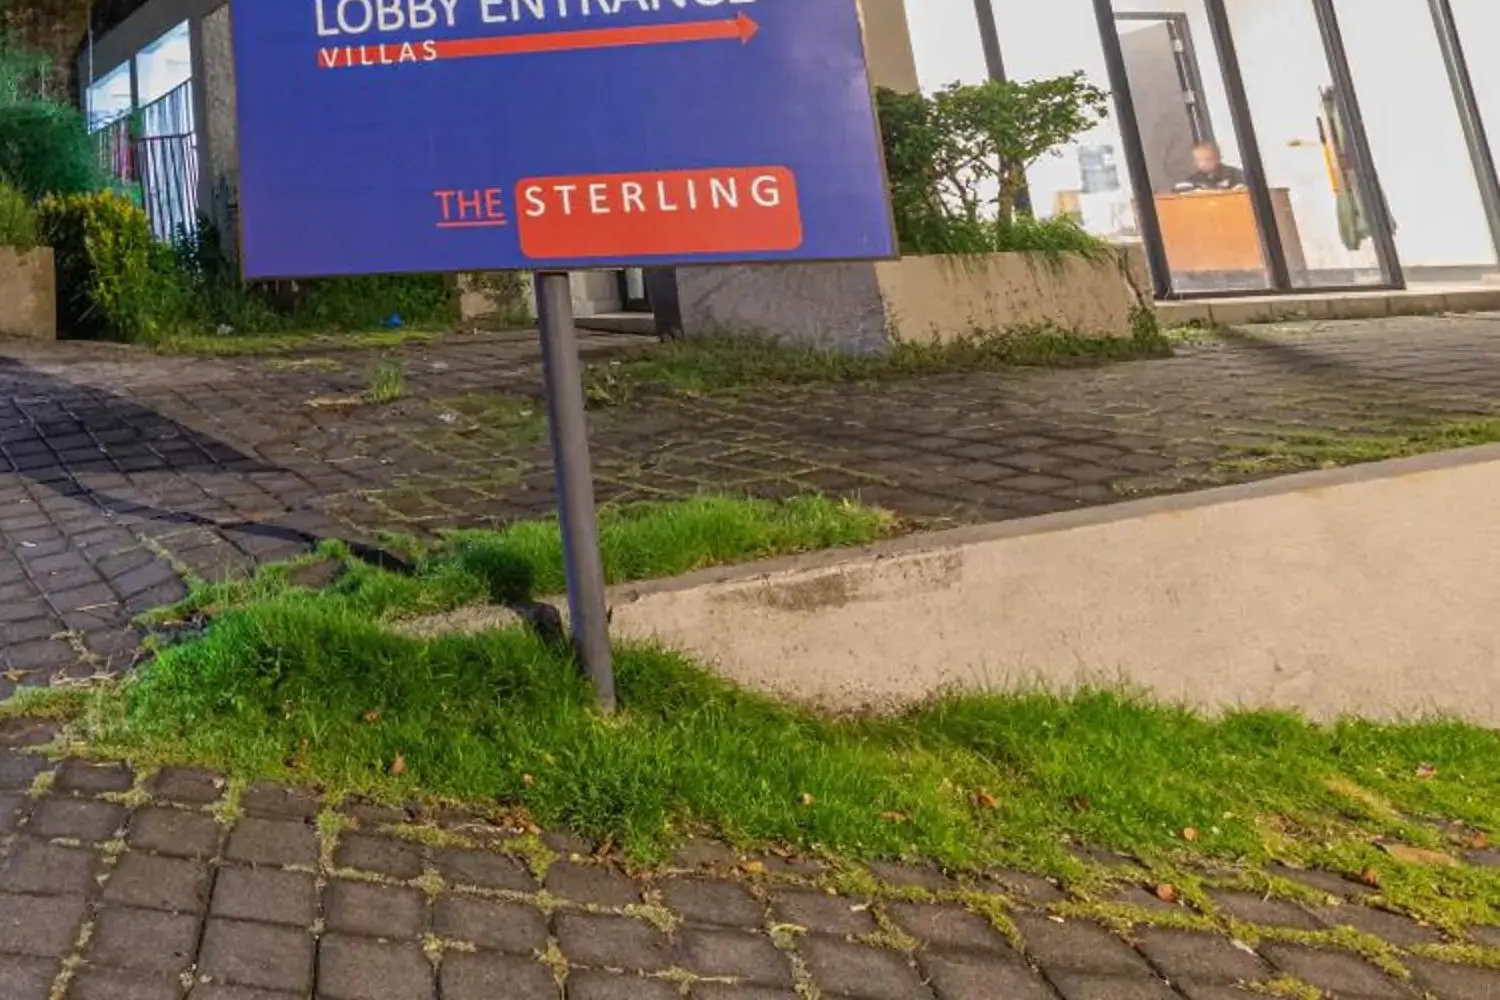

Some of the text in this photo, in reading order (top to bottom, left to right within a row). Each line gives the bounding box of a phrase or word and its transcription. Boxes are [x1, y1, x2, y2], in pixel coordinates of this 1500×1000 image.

[322, 39, 438, 68] VILLAS
[434, 175, 781, 220] THE STERLING
